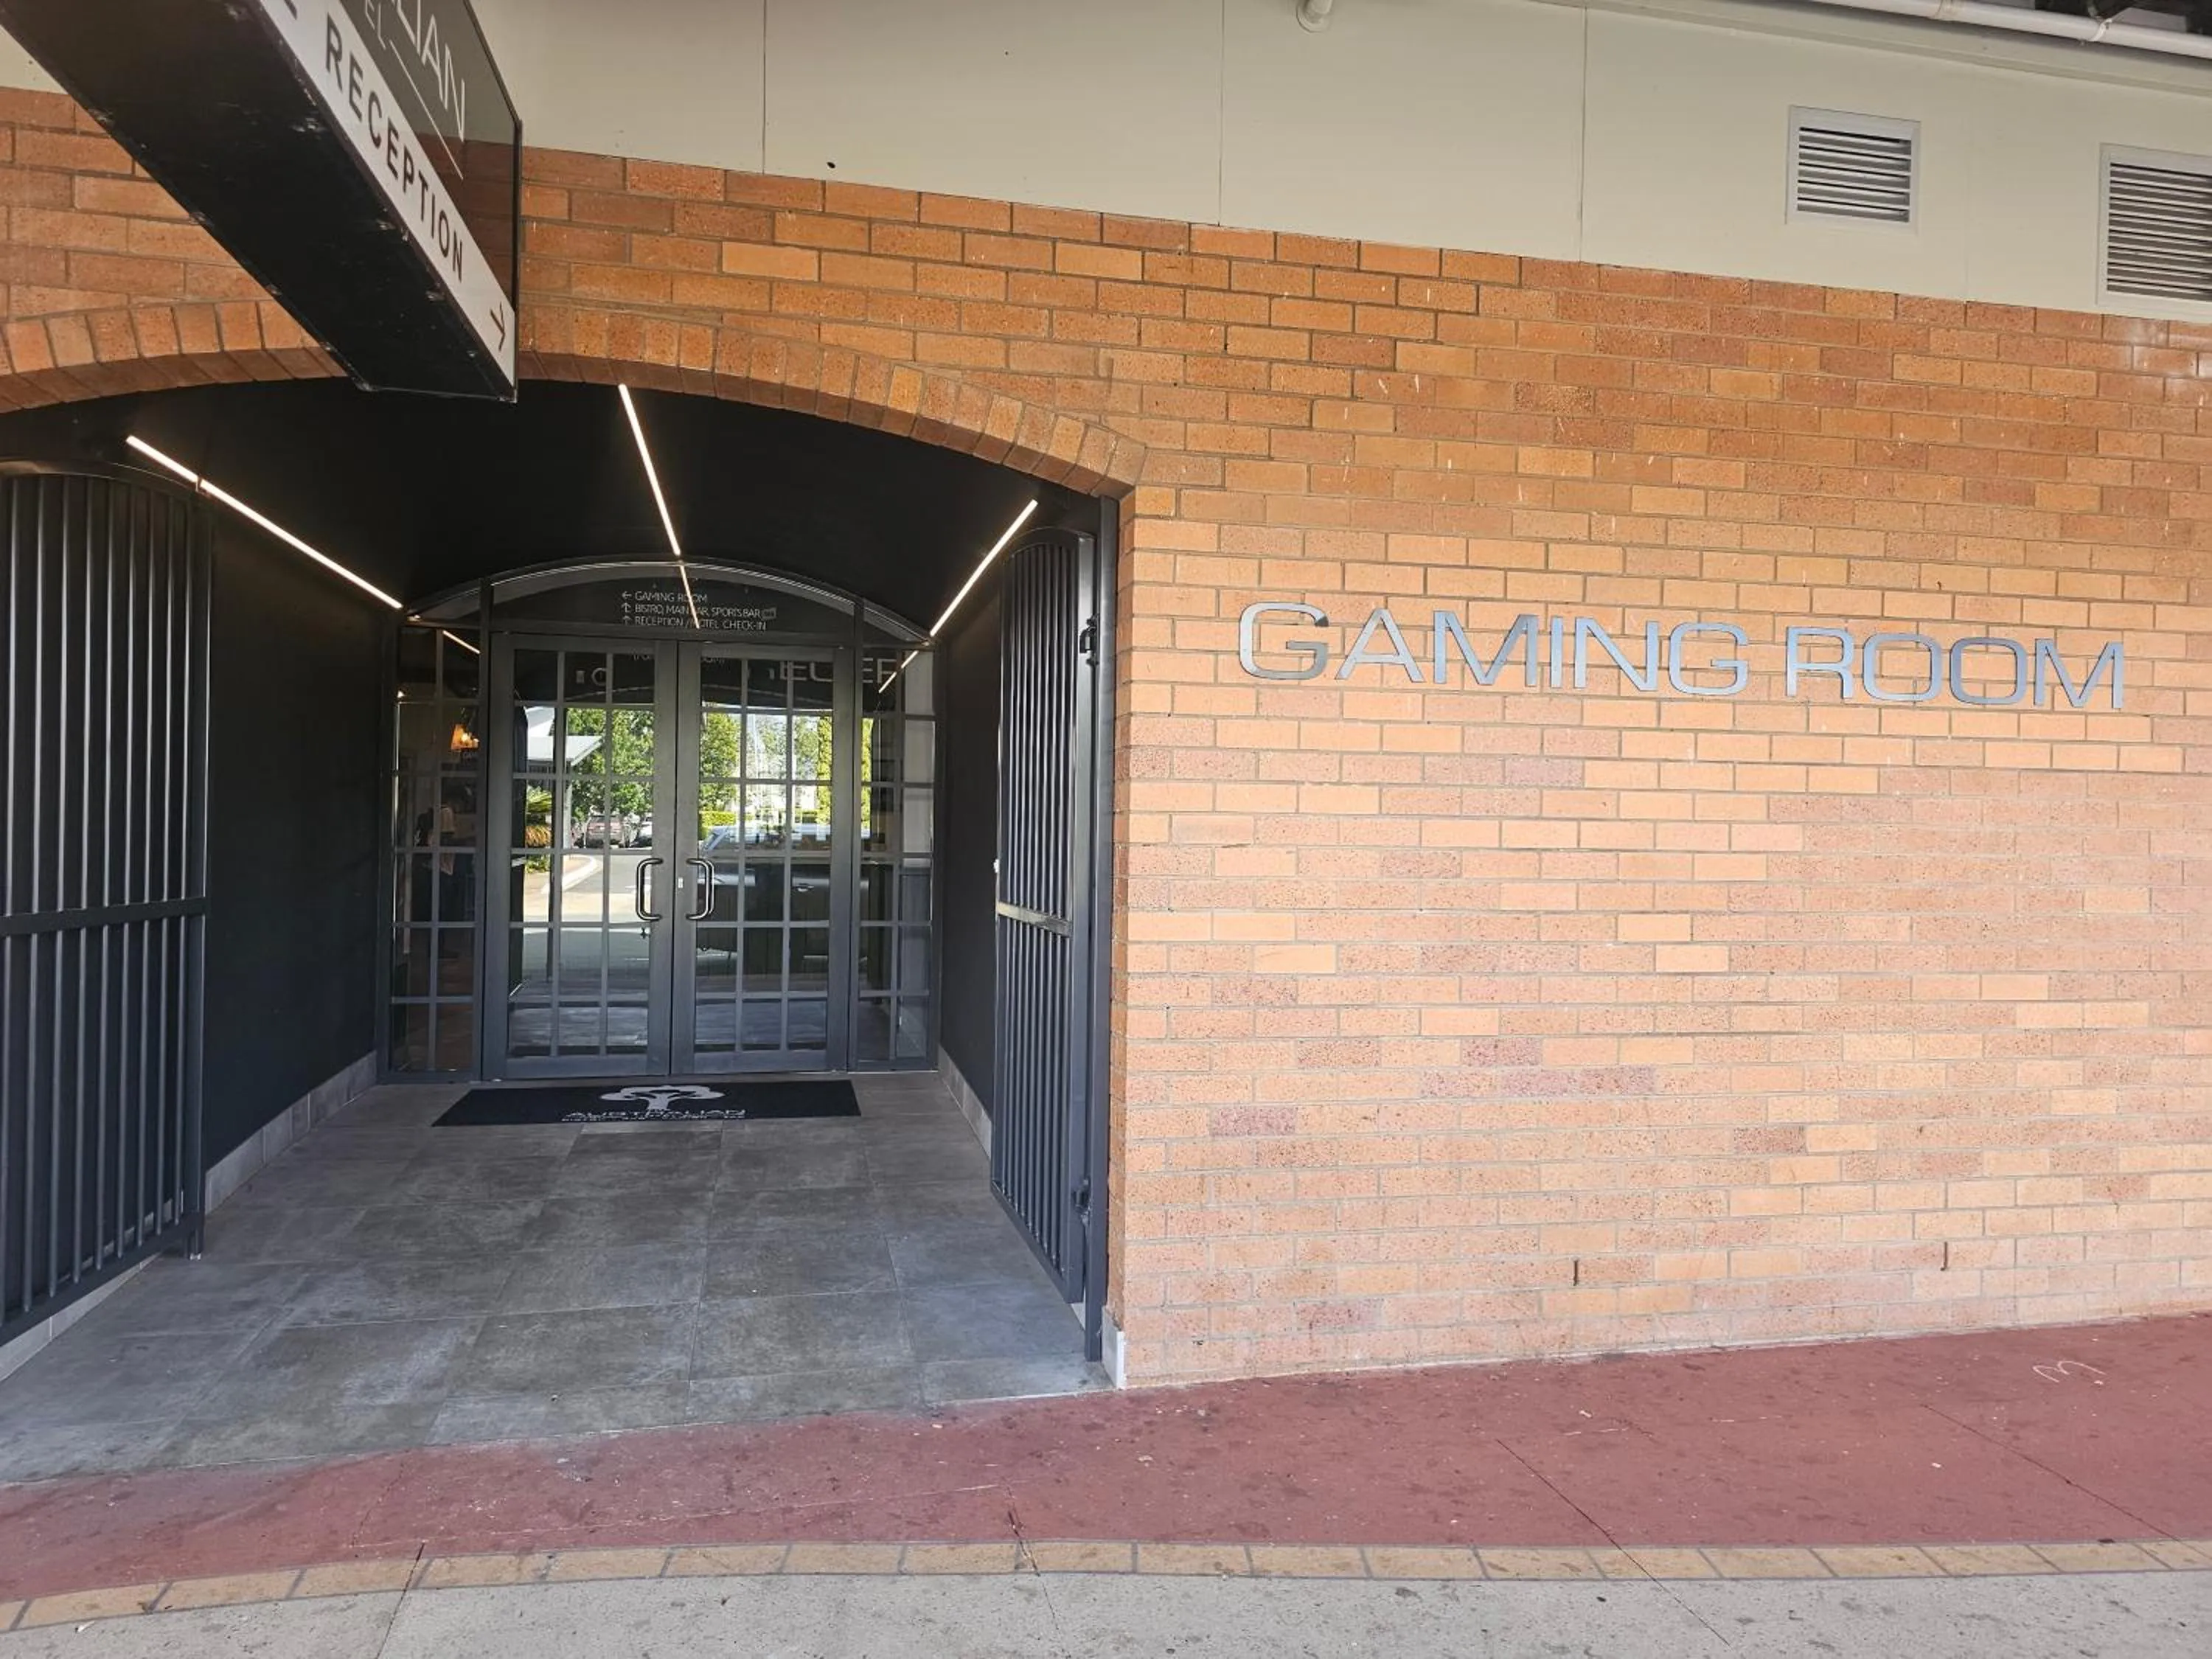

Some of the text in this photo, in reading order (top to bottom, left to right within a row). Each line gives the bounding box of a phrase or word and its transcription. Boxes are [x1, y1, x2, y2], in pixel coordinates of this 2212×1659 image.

[326, 12, 464, 282] RECEPTION
[634, 591, 675, 602] GAMING
[635, 616, 684, 626] RECEPTION
[1238, 601, 2124, 709] GAMING ROOM
